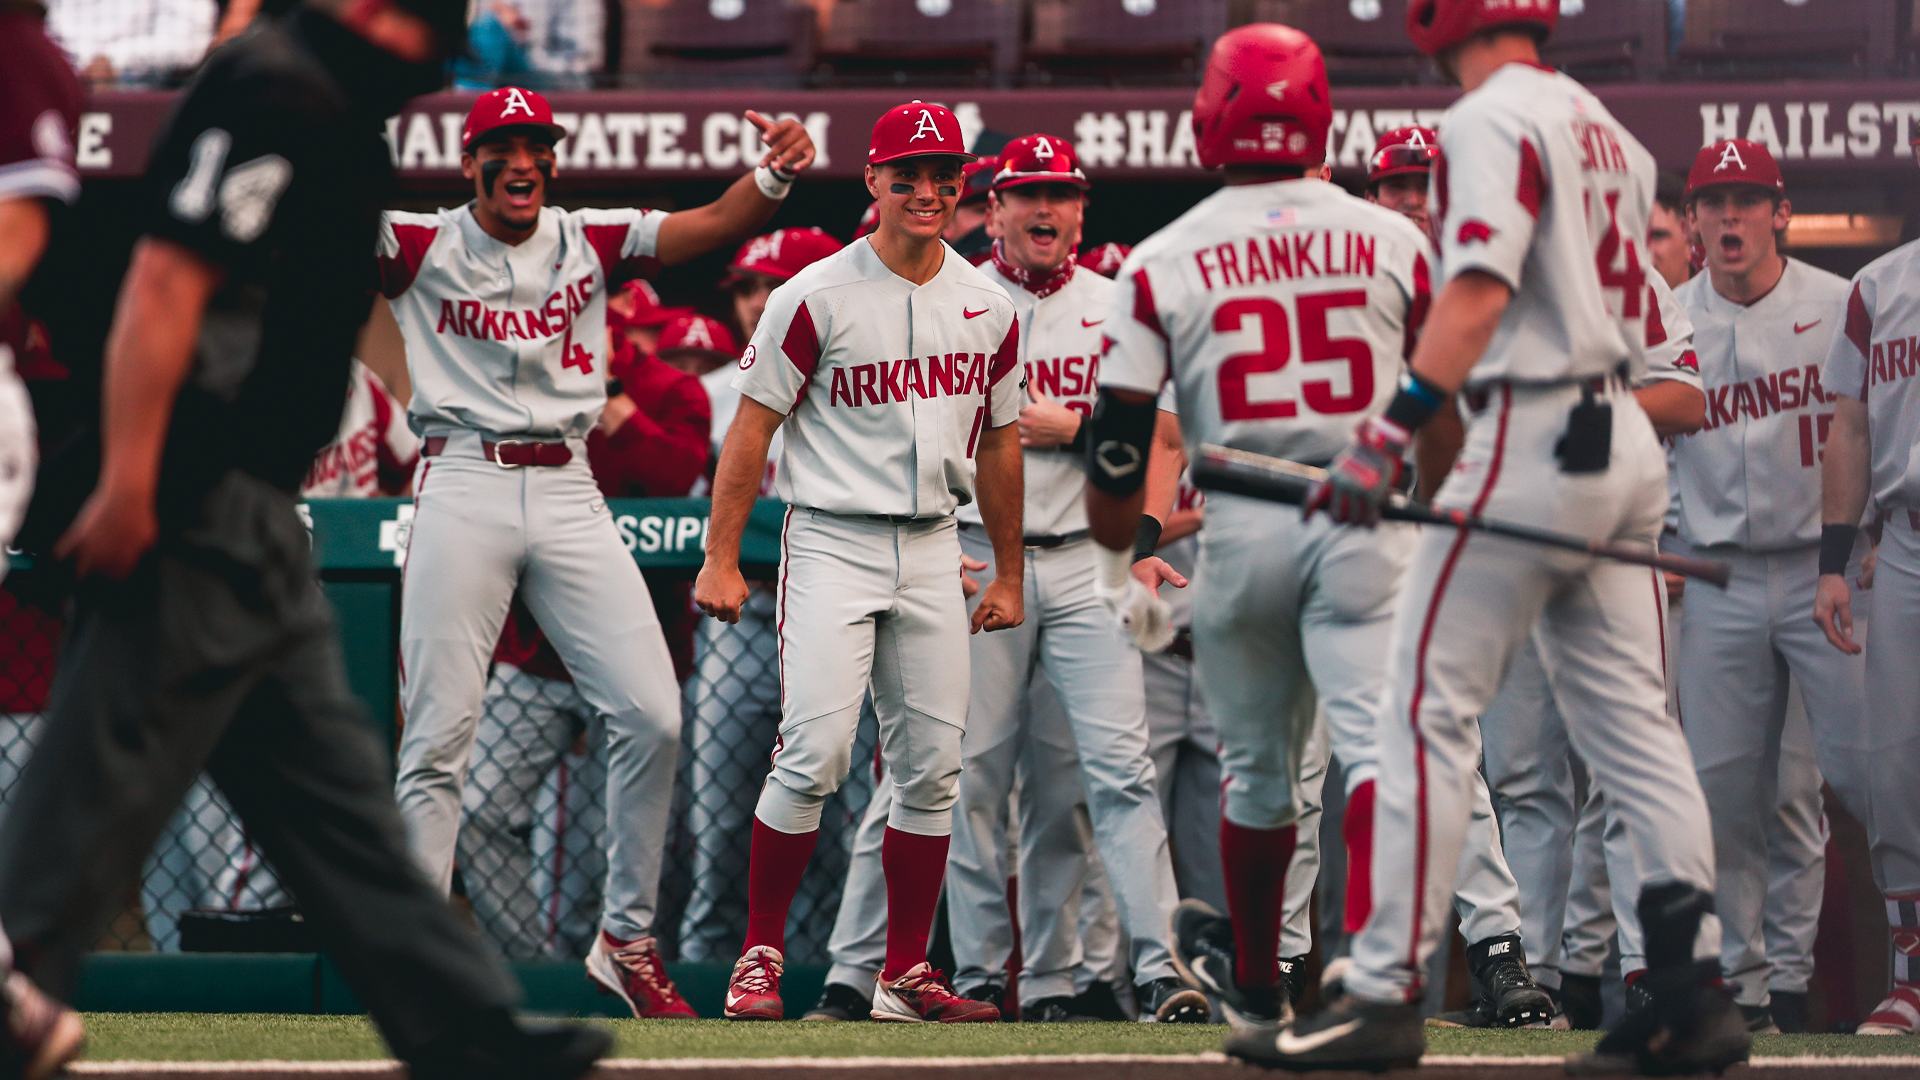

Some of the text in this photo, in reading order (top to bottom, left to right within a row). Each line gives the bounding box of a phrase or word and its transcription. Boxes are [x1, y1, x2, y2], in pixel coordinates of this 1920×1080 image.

[500, 88, 535, 118] A
[909, 109, 945, 143] A
[1713, 141, 1747, 174] A
[1194, 229, 1375, 290] FRANKLIN
[561, 325, 594, 375] 4
[1212, 287, 1374, 421] 25
[1488, 941, 1510, 957] NIKE
